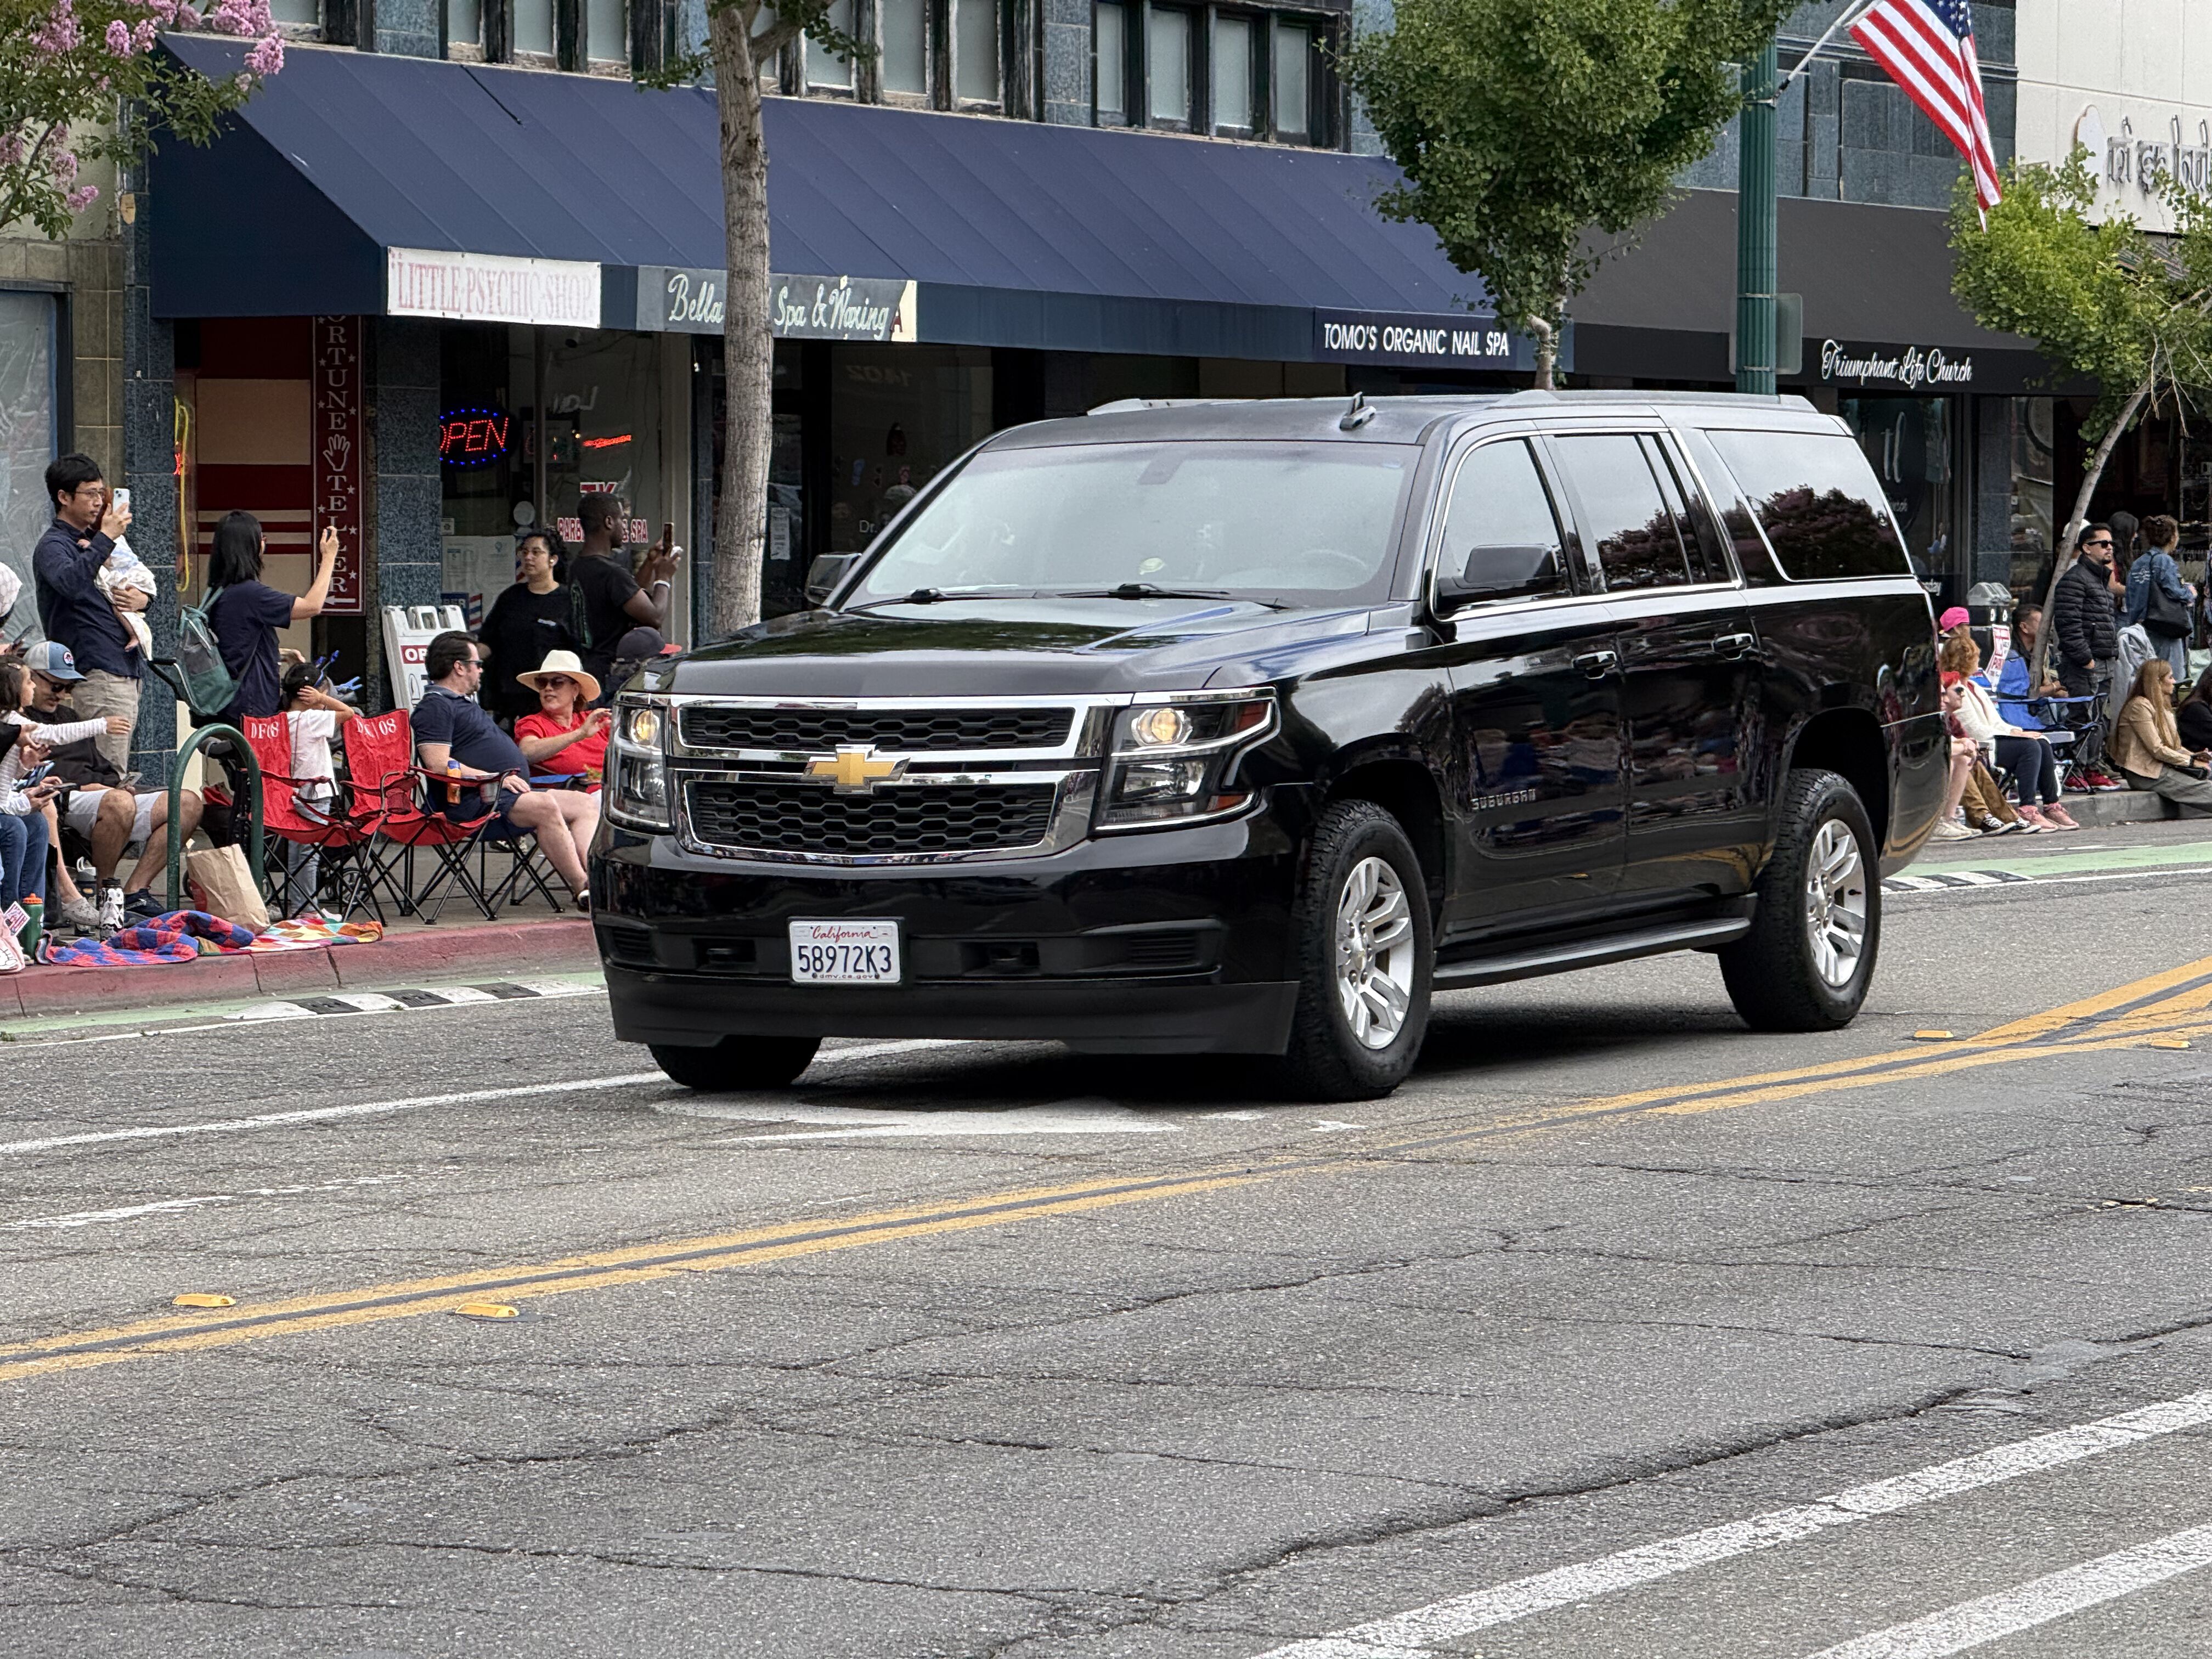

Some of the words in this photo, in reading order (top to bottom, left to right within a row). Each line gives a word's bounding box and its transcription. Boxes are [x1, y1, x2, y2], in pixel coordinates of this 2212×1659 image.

[397, 261, 461, 312] LITTLE
[465, 267, 541, 318] PSYCHIC
[668, 274, 724, 324] Bella
[774, 285, 806, 335] Spa
[811, 283, 828, 328] &
[829, 287, 890, 341] Waxing
[1324, 323, 1377, 351] TOMO'S
[1383, 326, 1447, 355] ORGANIC
[1452, 330, 1481, 356] NAIL
[1486, 331, 1510, 356] SPA
[1821, 339, 1900, 386] Triumphant
[1898, 346, 1925, 390] Life
[1926, 348, 1972, 383] Church
[326, 475, 348, 592] TELER
[631, 519, 648, 543] SPA
[1470, 788, 1536, 810] SUBURBAN
[812, 925, 878, 943] California
[798, 945, 891, 973] 58972K3
